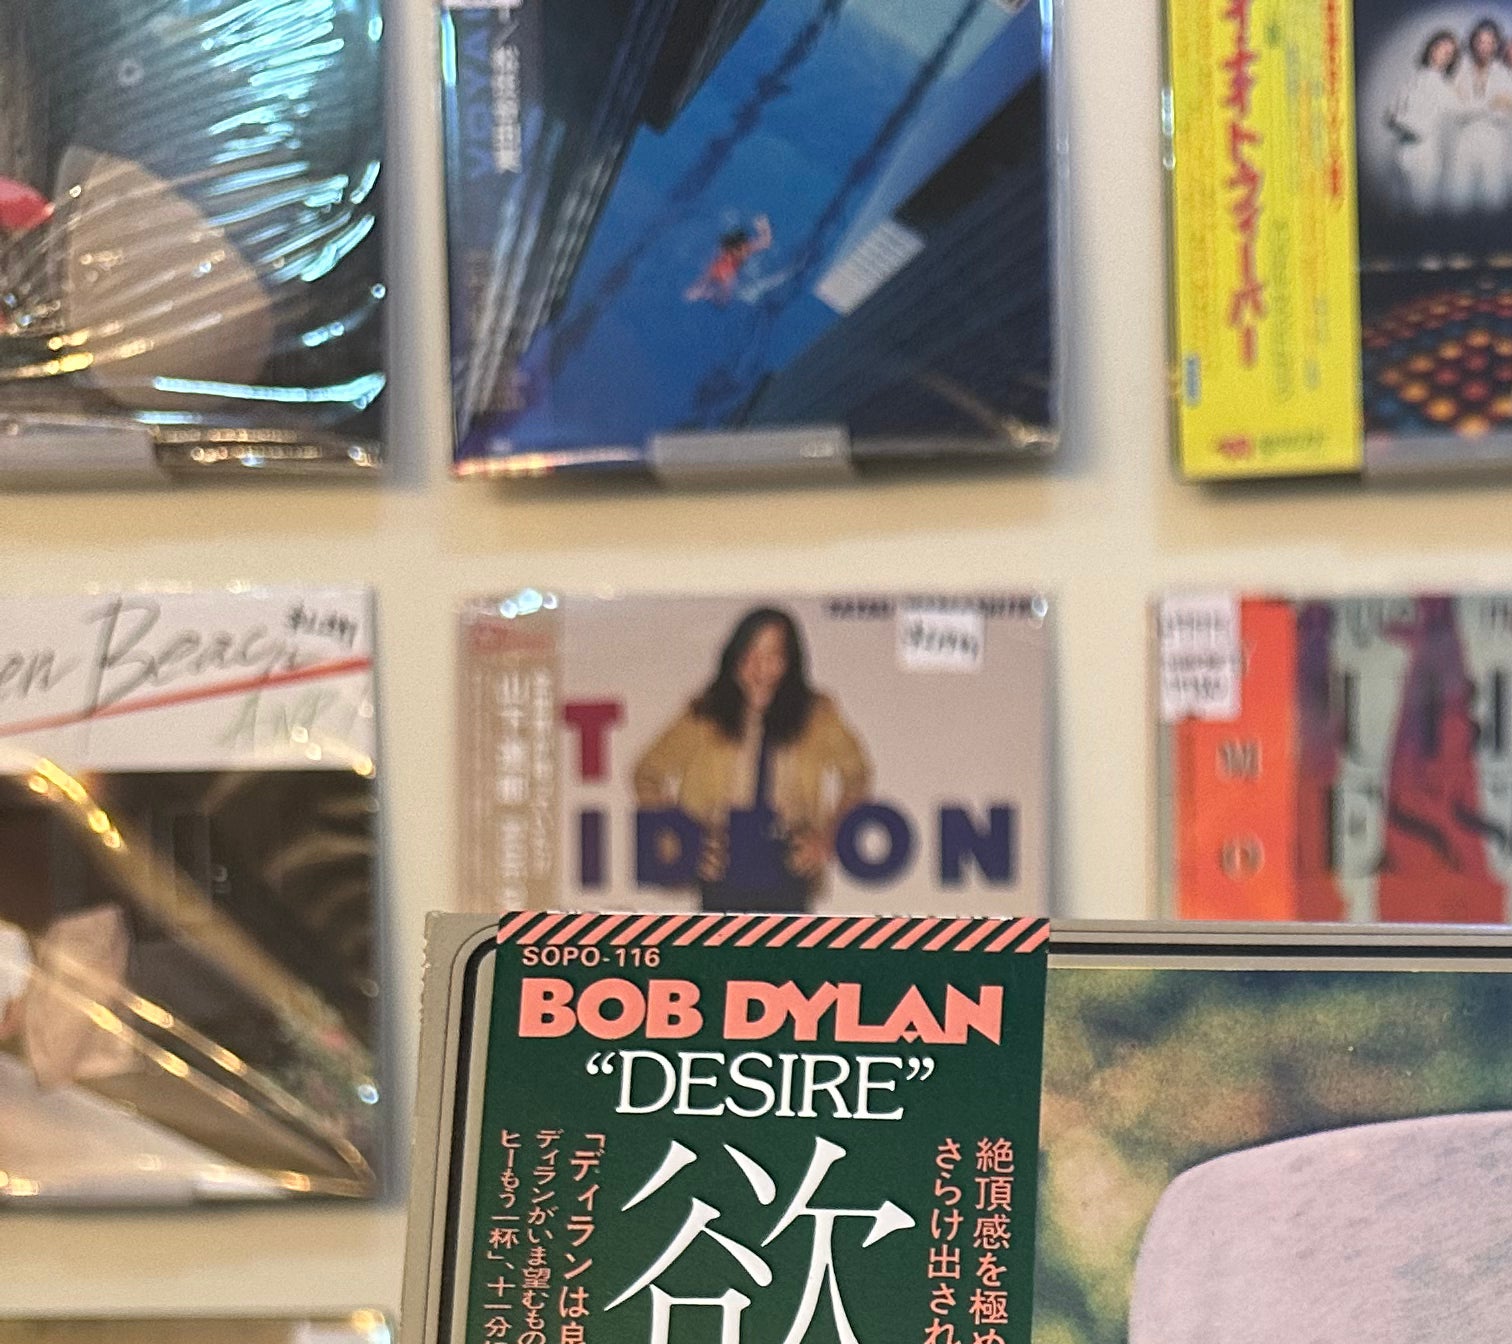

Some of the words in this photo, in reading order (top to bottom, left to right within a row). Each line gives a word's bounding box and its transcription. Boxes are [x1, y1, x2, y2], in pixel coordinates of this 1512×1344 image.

[522, 947, 661, 968] SOPO-116
[518, 977, 703, 1040] BOB
[723, 979, 1003, 1046] DYLAN
